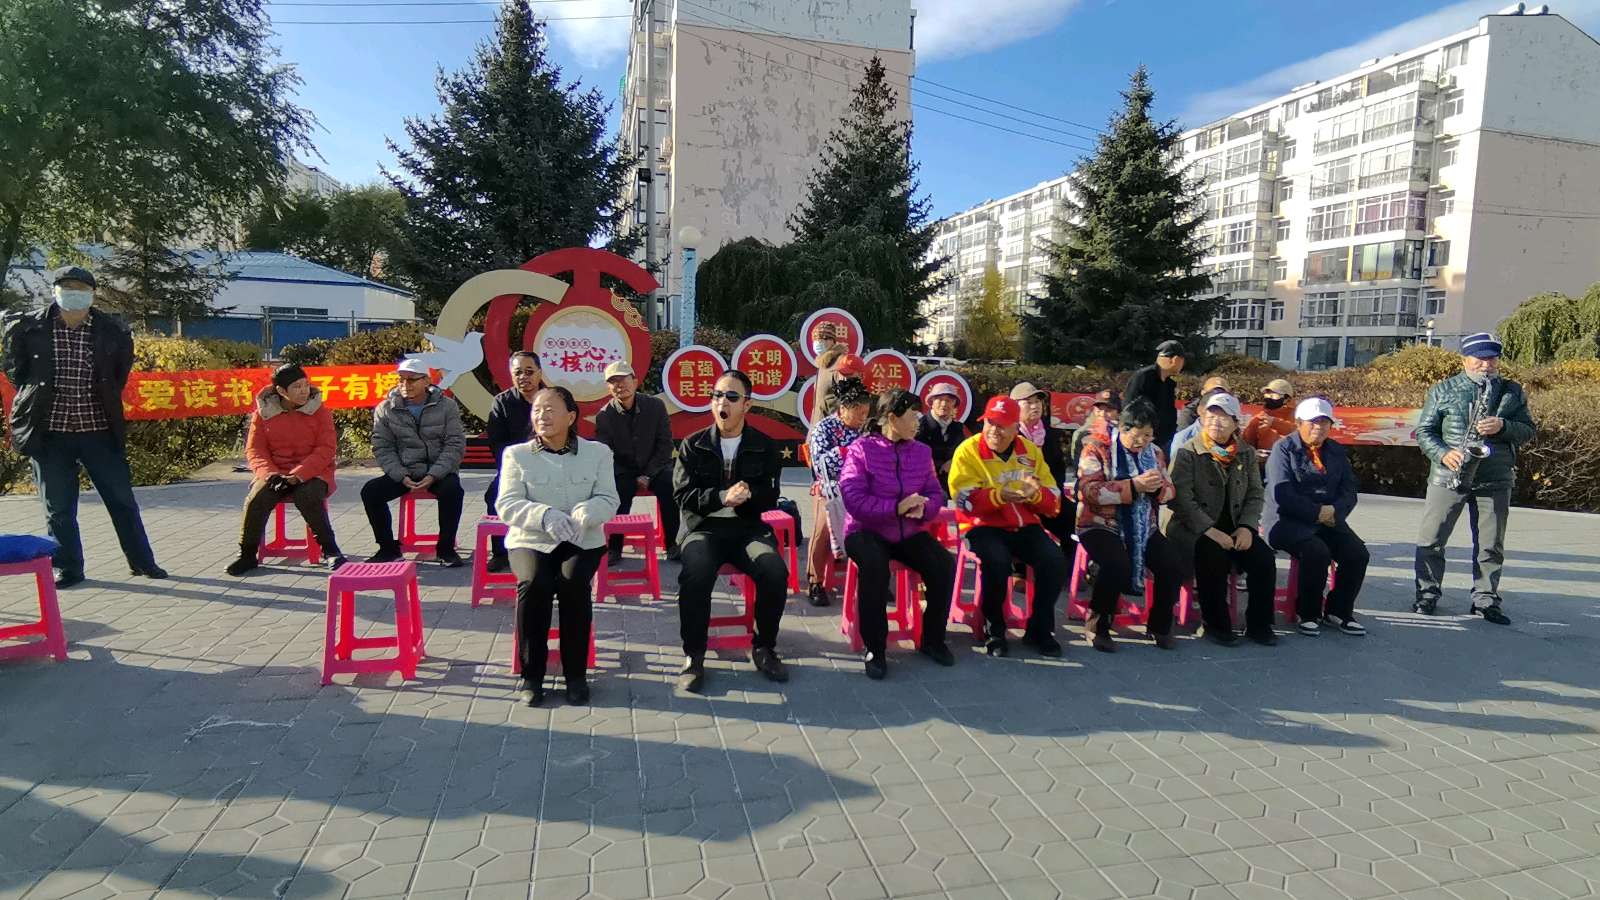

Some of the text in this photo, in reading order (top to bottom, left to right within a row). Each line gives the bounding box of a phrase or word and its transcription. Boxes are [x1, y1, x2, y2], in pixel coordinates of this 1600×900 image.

[559, 346, 607, 372] 核心
[748, 349, 782, 366] 文明
[678, 360, 714, 378] 富强
[749, 369, 783, 386] 和谐
[871, 363, 903, 379] 公正
[122, 377, 254, 412] 爱读书
[679, 380, 714, 397] 民主
